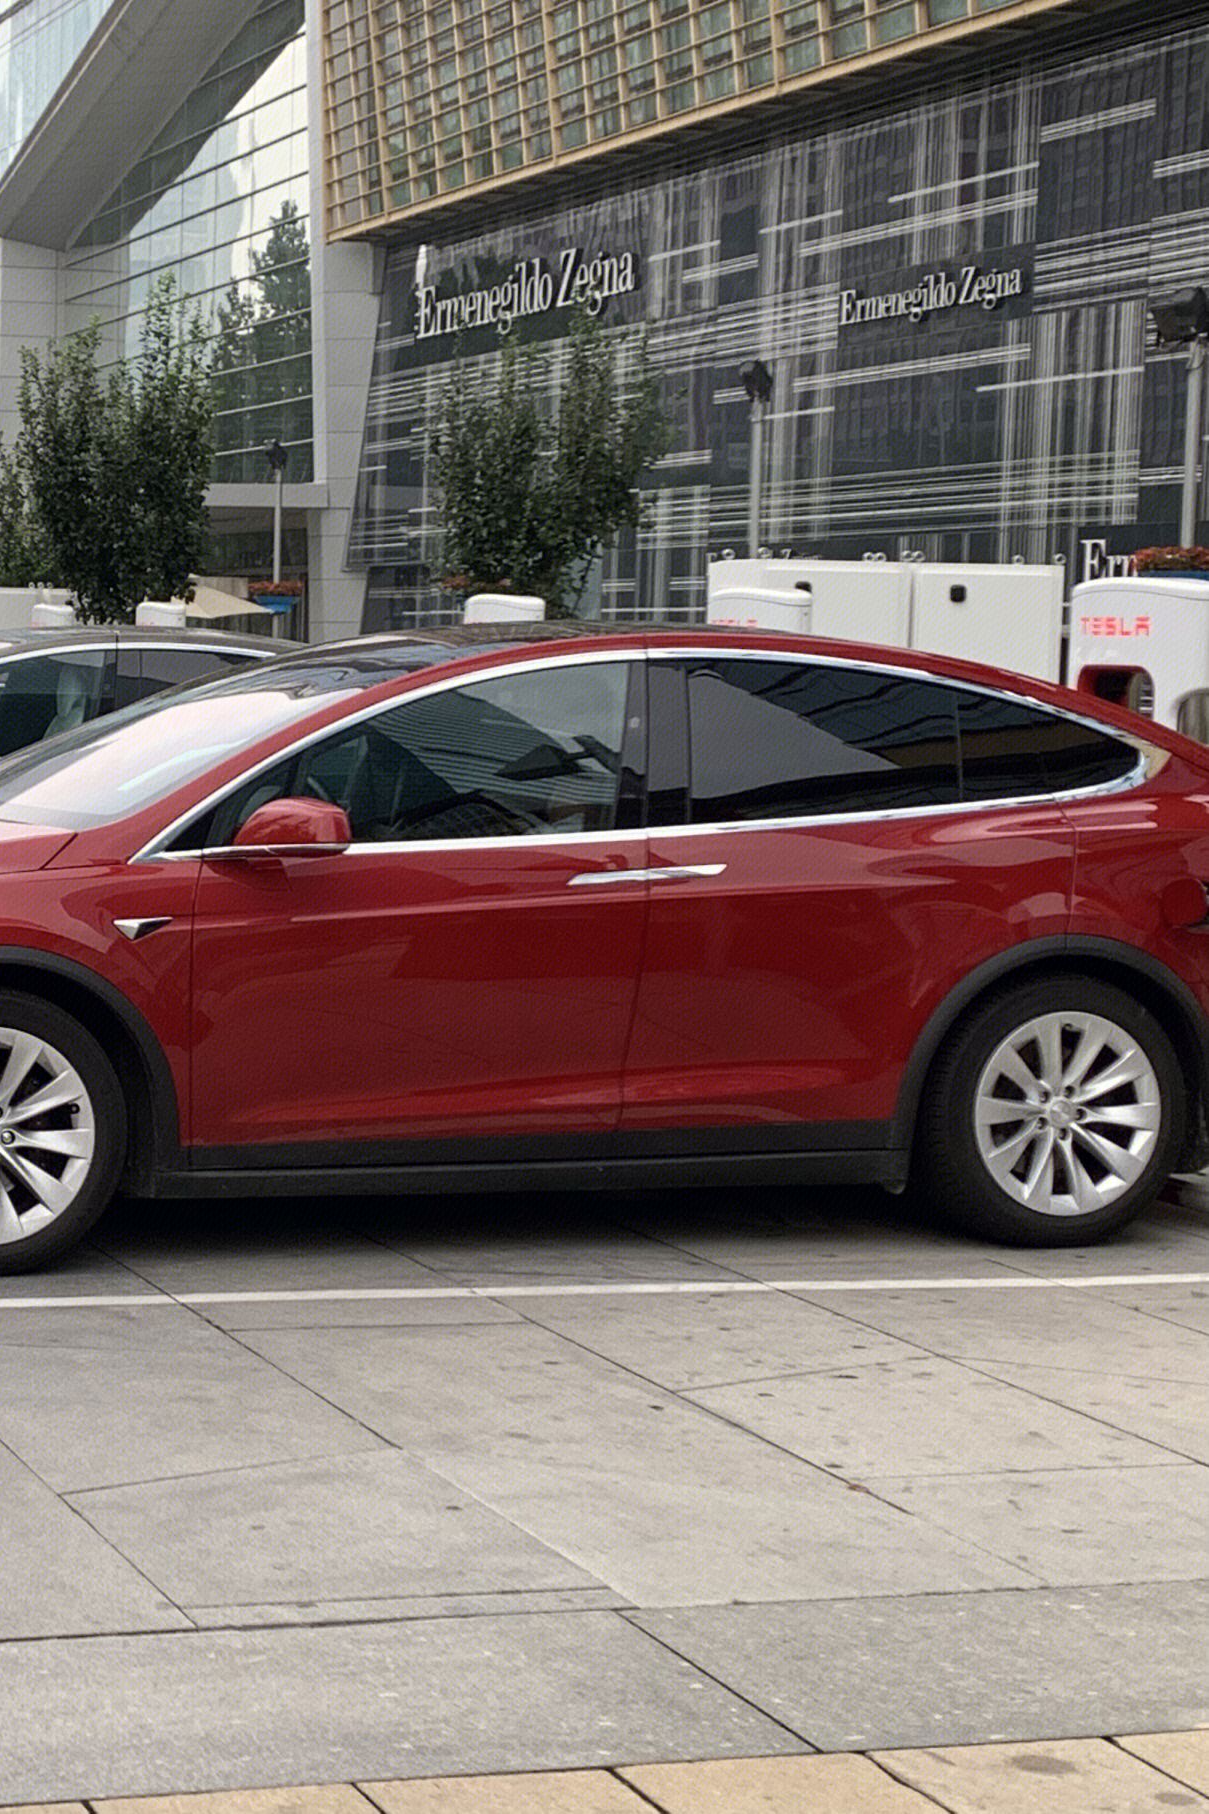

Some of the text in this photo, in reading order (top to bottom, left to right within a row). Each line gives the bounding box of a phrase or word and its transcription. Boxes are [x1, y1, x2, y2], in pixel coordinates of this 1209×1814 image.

[416, 247, 636, 339] Ermenegildo Zegna
[840, 265, 1022, 325] Ermenegildo Zegna
[1080, 616, 1150, 636] TESLA
